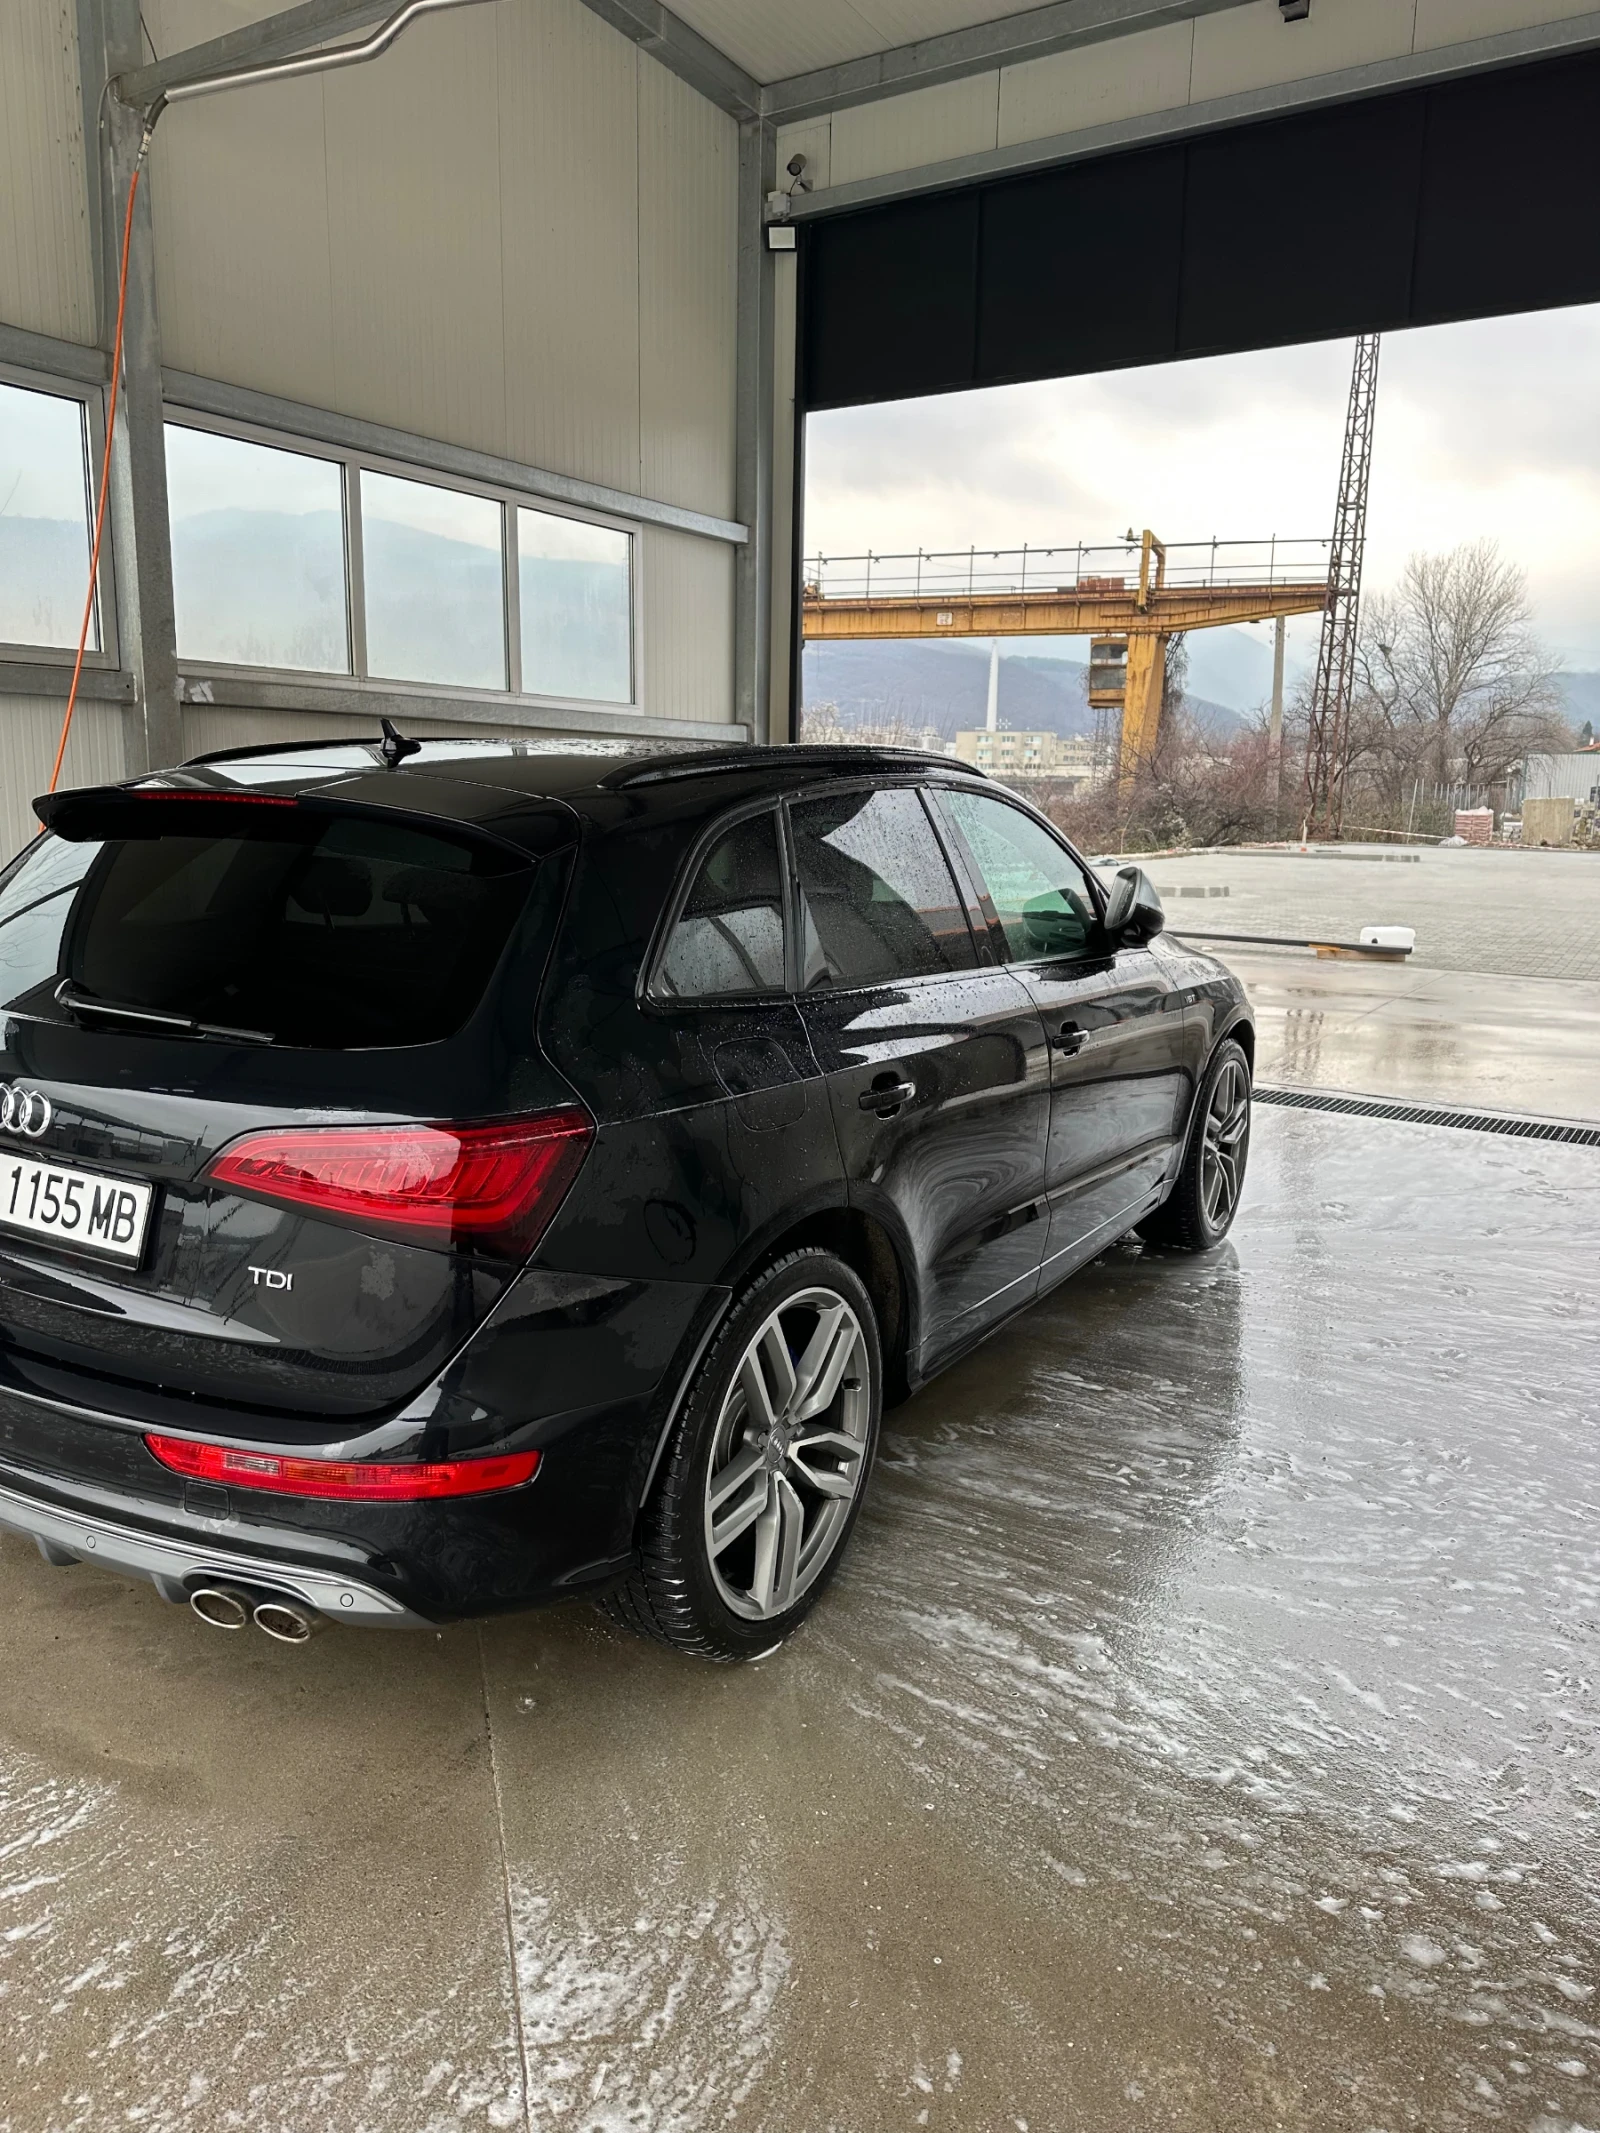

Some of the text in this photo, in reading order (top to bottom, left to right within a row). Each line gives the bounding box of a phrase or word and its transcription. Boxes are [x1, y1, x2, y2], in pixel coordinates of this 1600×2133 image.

[9, 1166, 137, 1243] 1155 MB
[247, 1265, 293, 1291] TDI
